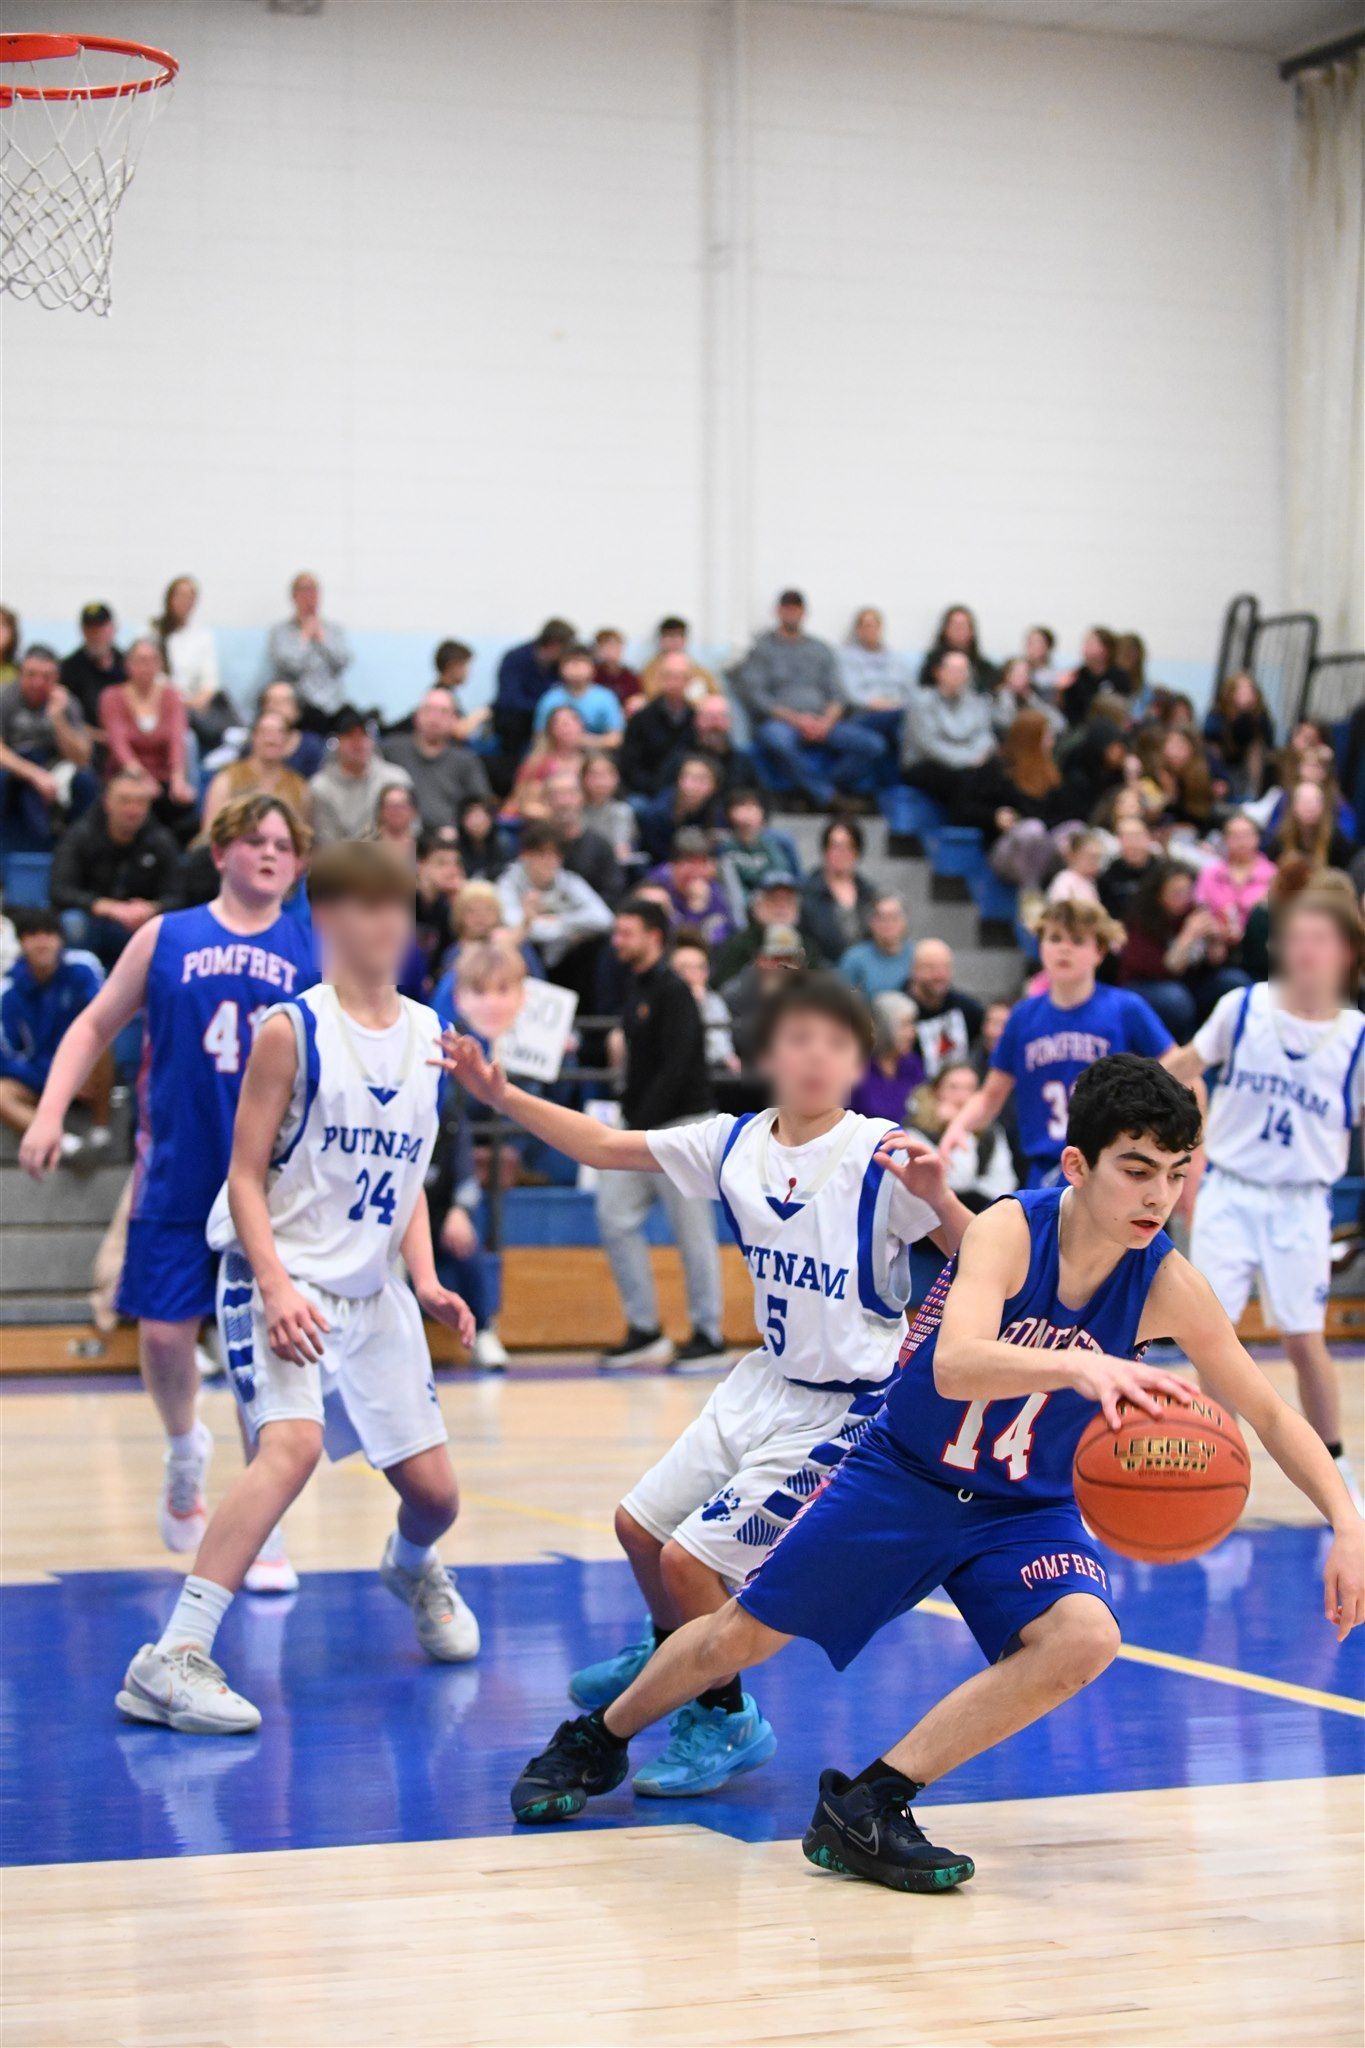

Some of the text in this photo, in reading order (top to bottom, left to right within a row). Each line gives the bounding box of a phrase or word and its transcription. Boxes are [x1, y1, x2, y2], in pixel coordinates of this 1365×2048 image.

[181, 943, 298, 994] POMFRET
[202, 999, 268, 1074] 4
[1024, 1030, 1112, 1074] POMFRET
[1042, 1079, 1078, 1141] 3
[1236, 1070, 1330, 1119] PUTNAM
[1260, 1103, 1294, 1148] 14
[347, 1167, 397, 1226] 24
[742, 1243, 850, 1301] TNAM
[940, 1390, 1050, 1484] 14
[1112, 1436, 1217, 1462] LEGACY
